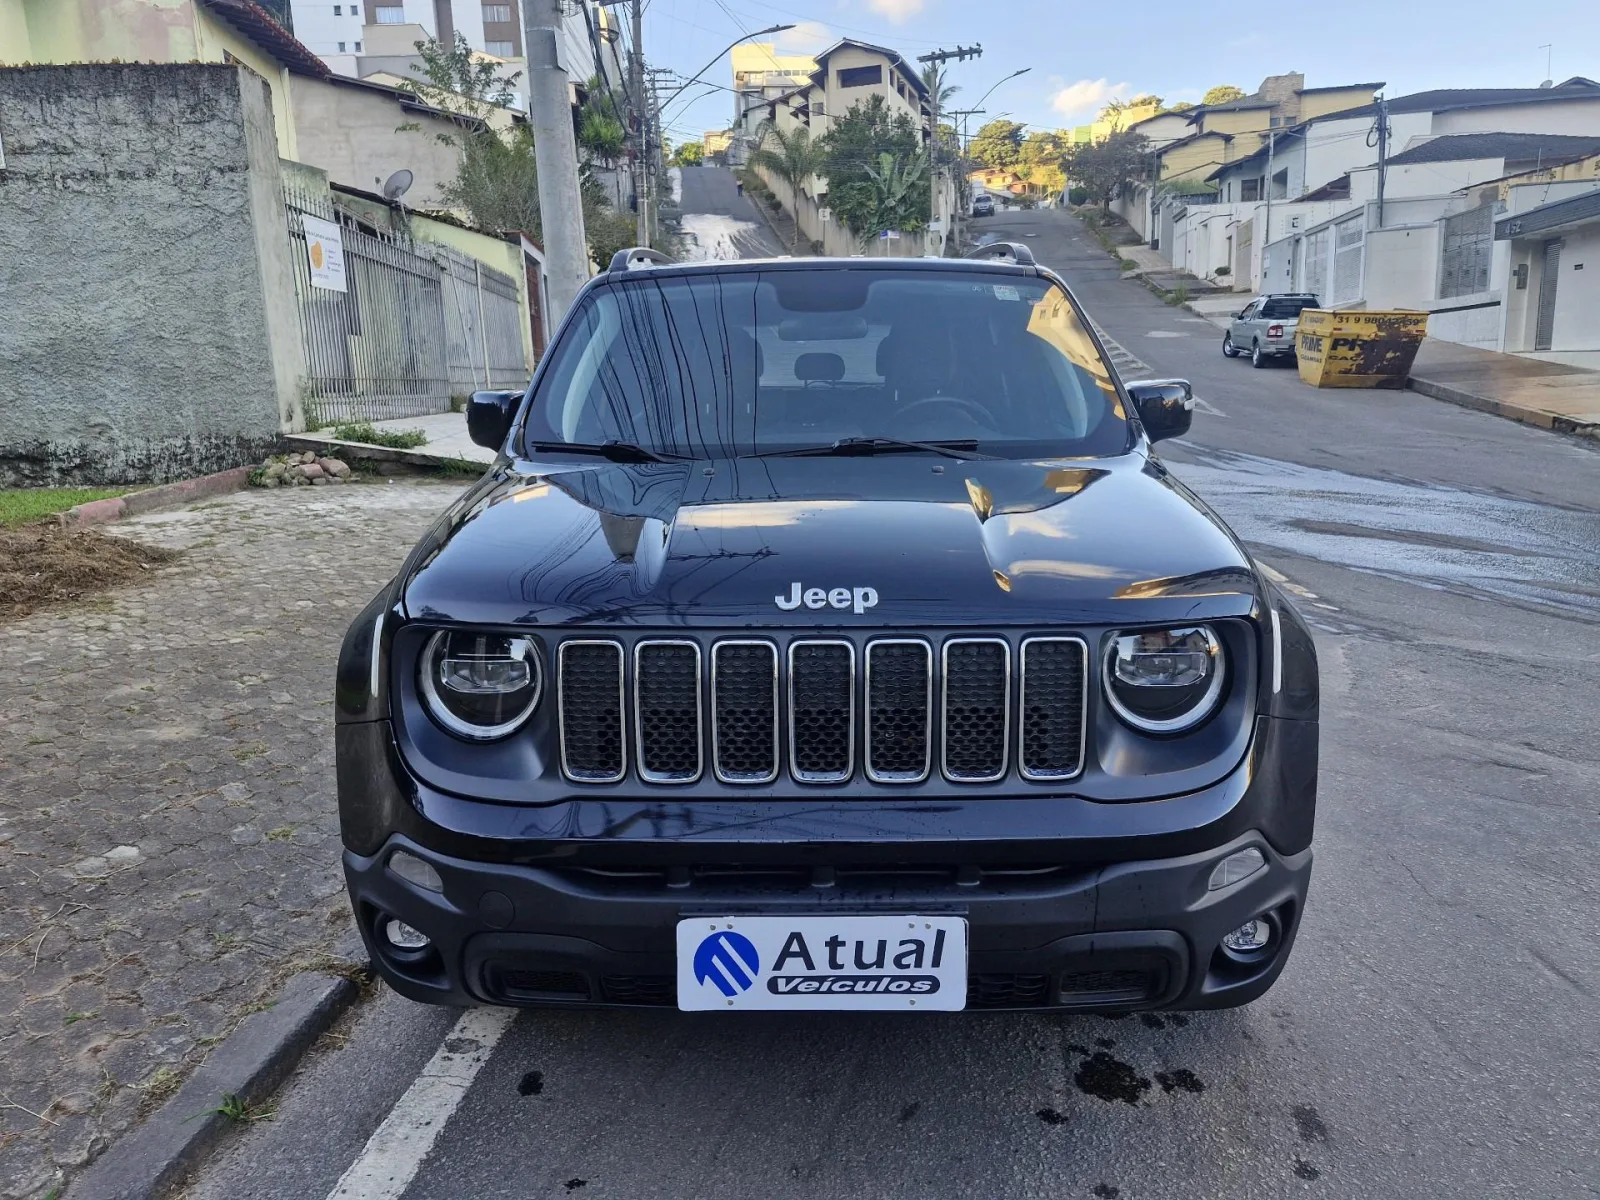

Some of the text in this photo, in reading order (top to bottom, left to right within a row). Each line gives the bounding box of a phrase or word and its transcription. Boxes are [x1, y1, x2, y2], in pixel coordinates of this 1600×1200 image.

[1337, 316, 1350, 324] 31
[1354, 316, 1361, 324] 9
[1301, 335, 1323, 352] PRIME
[774, 582, 879, 615] Jeep
[771, 929, 946, 972] Atual
[776, 977, 933, 993] Veículos
